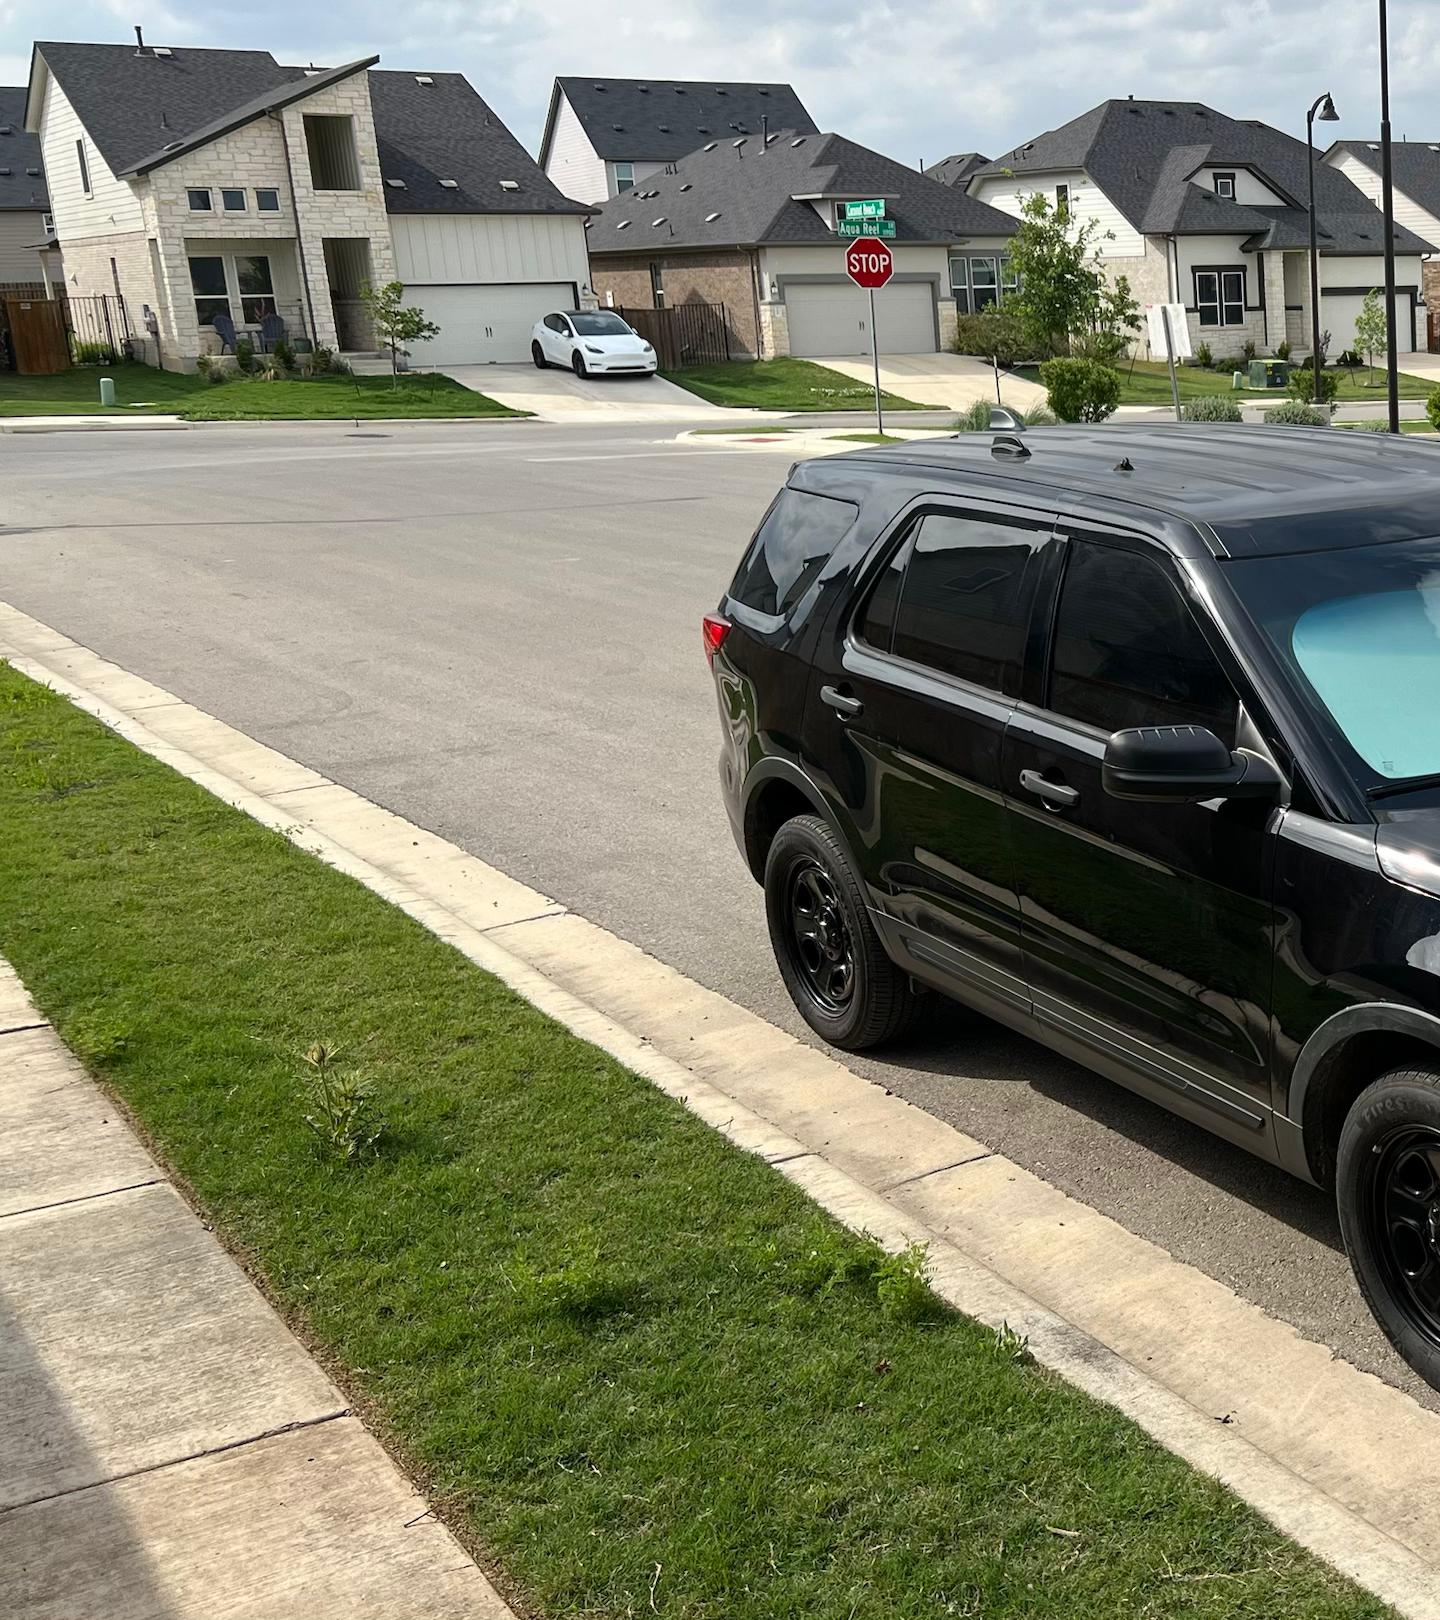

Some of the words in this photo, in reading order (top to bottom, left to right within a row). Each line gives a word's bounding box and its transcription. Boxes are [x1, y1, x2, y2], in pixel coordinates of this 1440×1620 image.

[840, 222, 860, 236] Aqua
[863, 223, 880, 235] Reel
[849, 253, 890, 273] STOP
